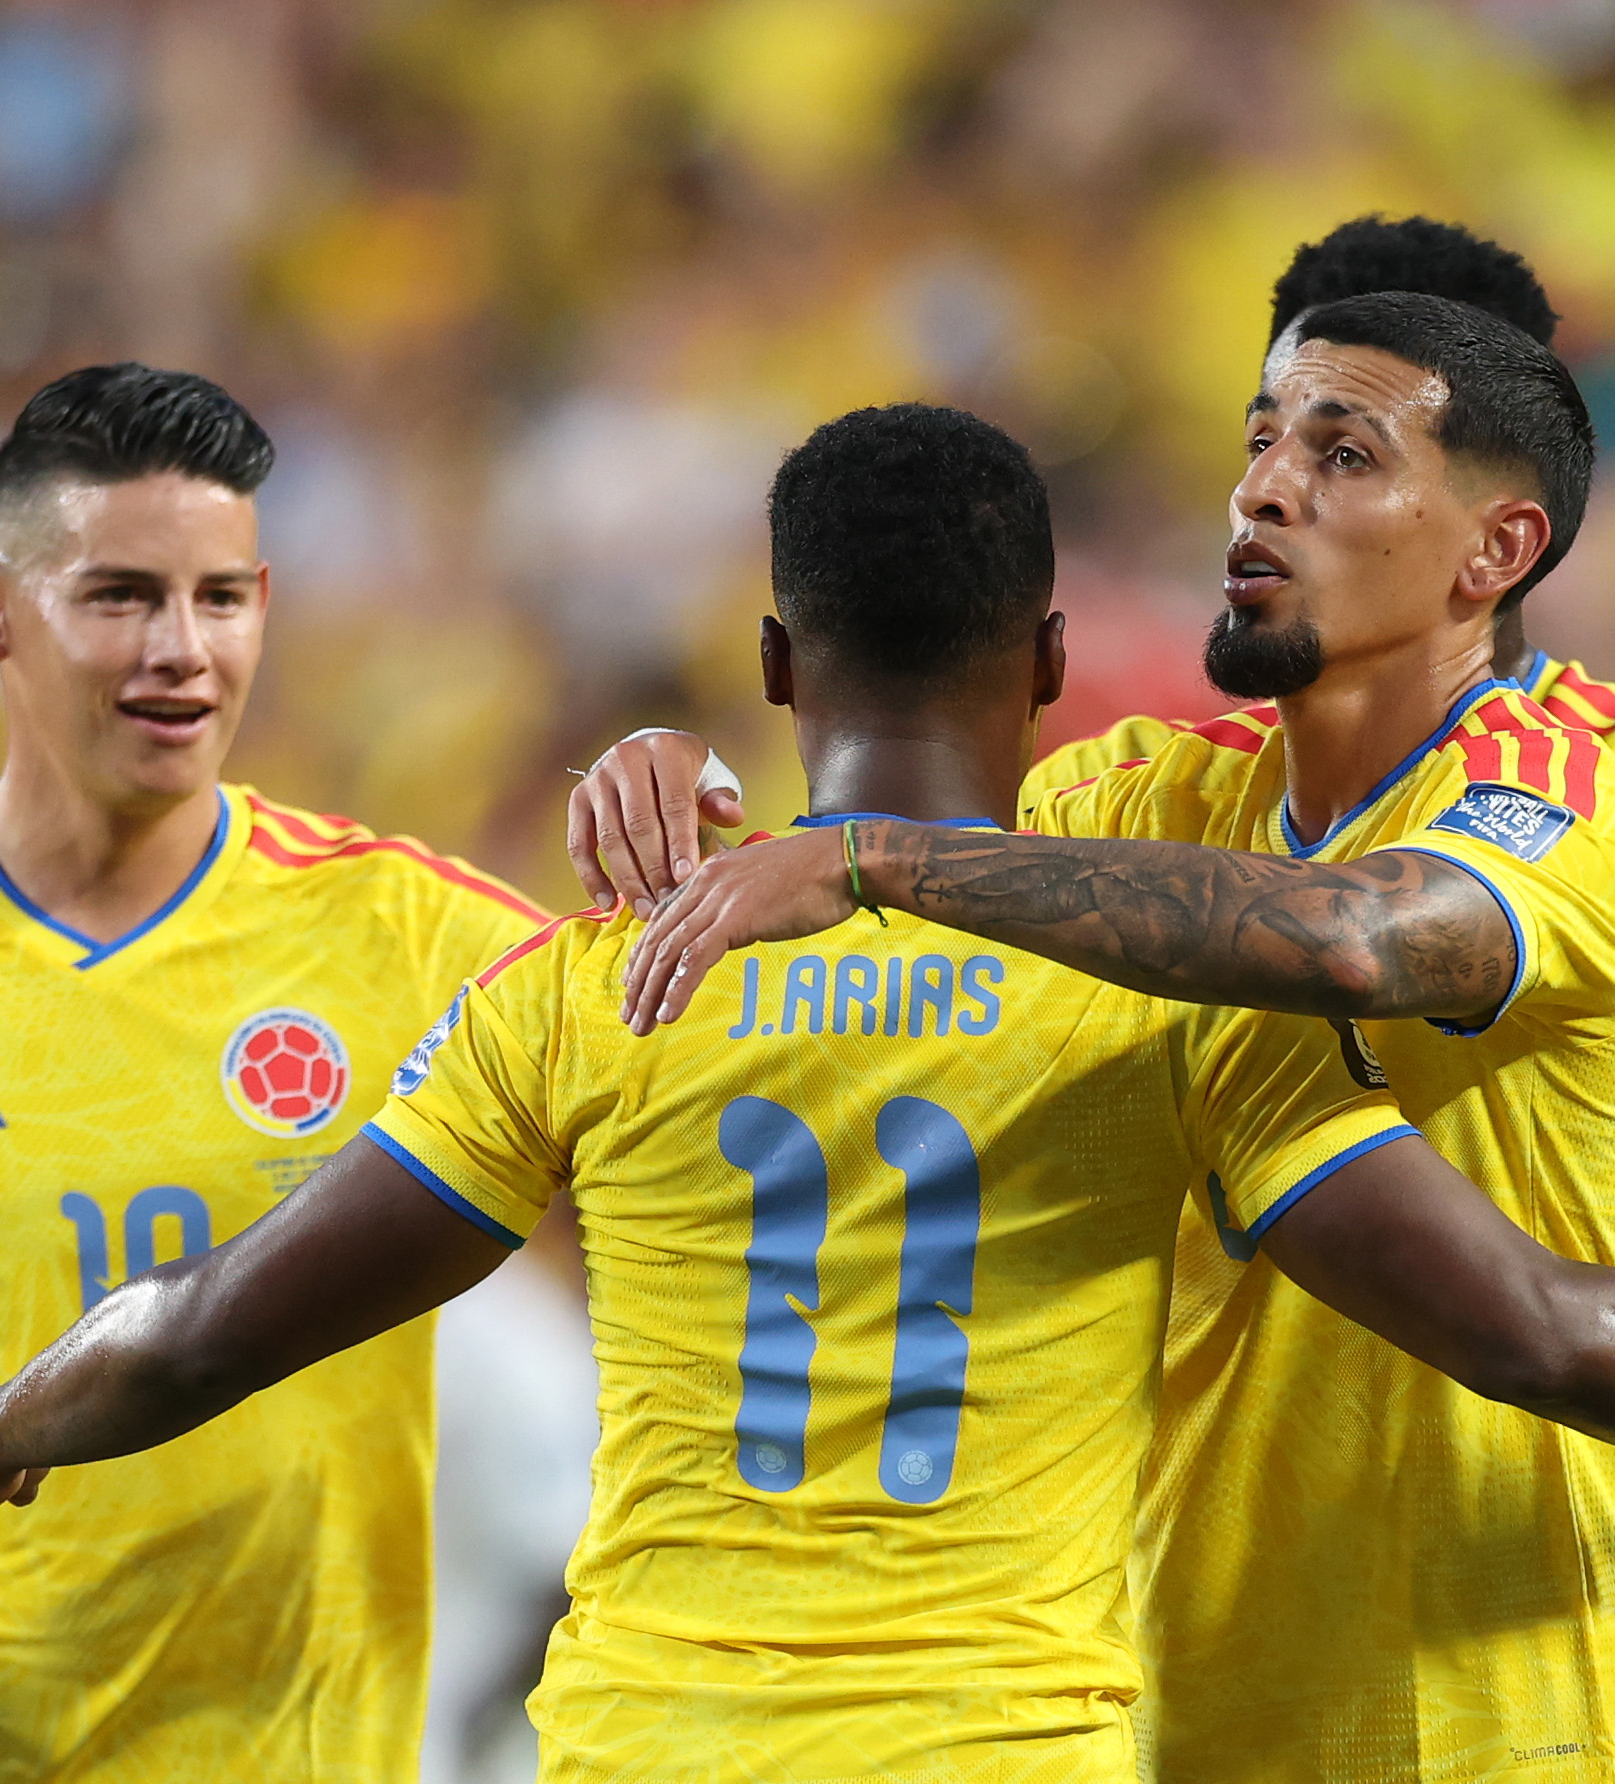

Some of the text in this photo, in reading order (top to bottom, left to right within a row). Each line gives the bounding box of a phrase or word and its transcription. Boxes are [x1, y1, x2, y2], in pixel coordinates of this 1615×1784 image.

[1469, 819, 1499, 842] FIFA
[1483, 813, 1533, 851] World
[727, 953, 1005, 1040] J.ARIAS
[717, 1094, 981, 1505] 11
